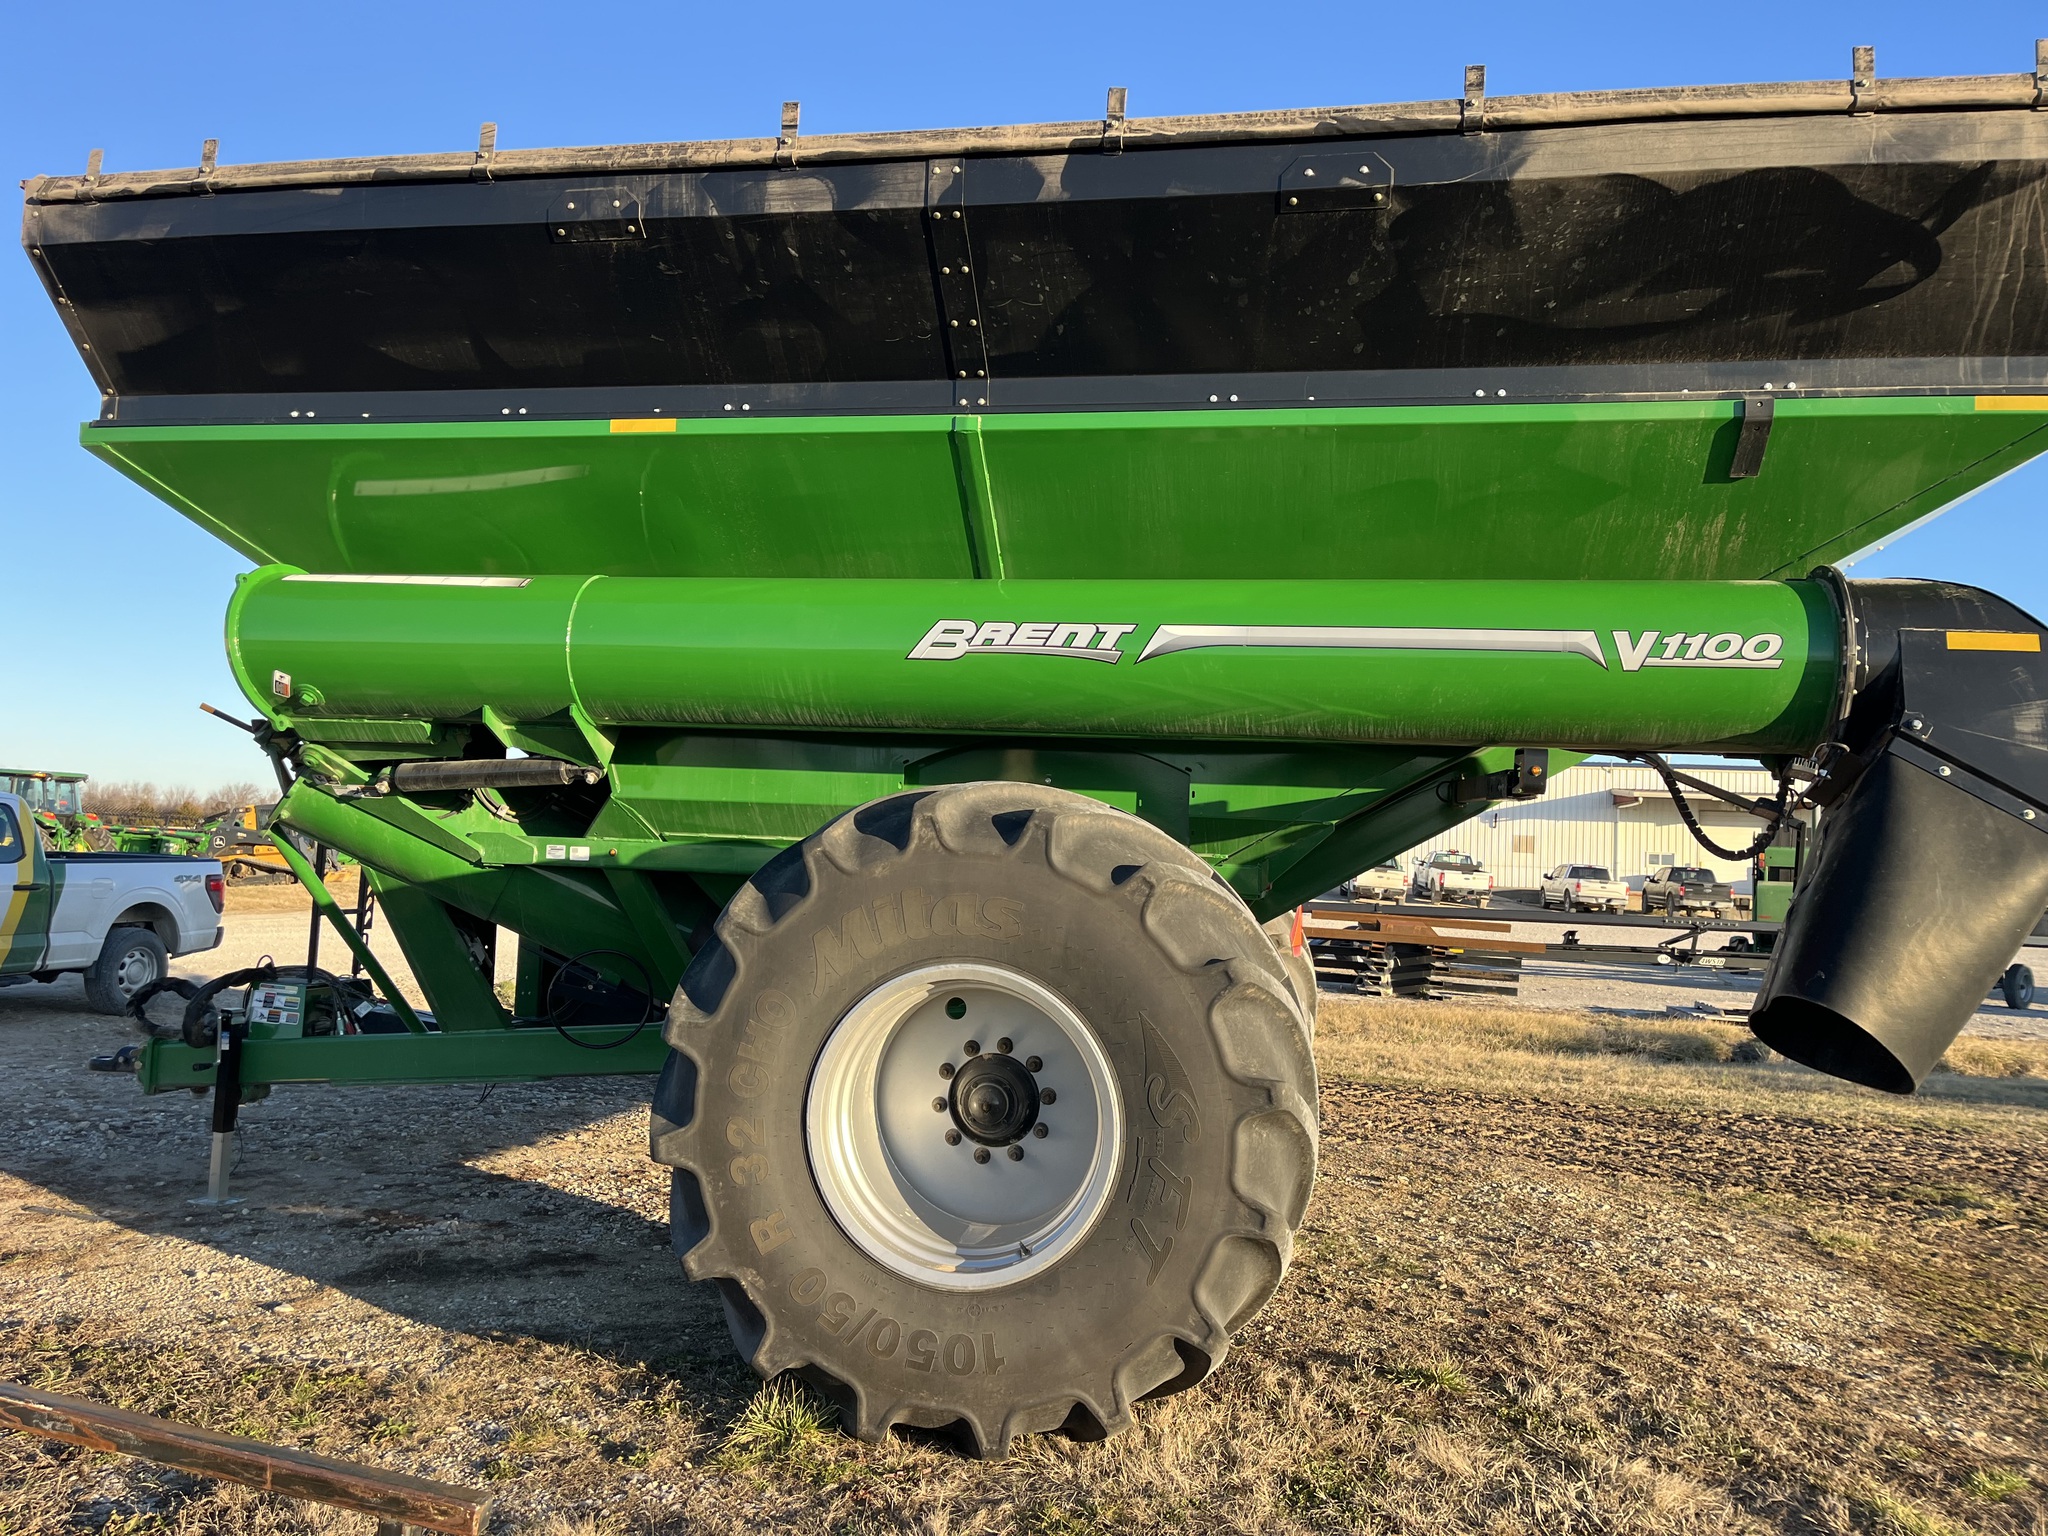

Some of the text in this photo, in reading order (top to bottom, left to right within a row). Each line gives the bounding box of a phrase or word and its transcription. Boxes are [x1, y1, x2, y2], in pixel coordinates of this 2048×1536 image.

[905, 619, 1139, 662] BRENT
[1611, 630, 1784, 672] V1100
[812, 887, 1025, 998] Mitas
[729, 989, 796, 1099] CHO
[726, 1116, 770, 1185] 32
[749, 1208, 796, 1256] R
[789, 1267, 1007, 1377] 1050/50
